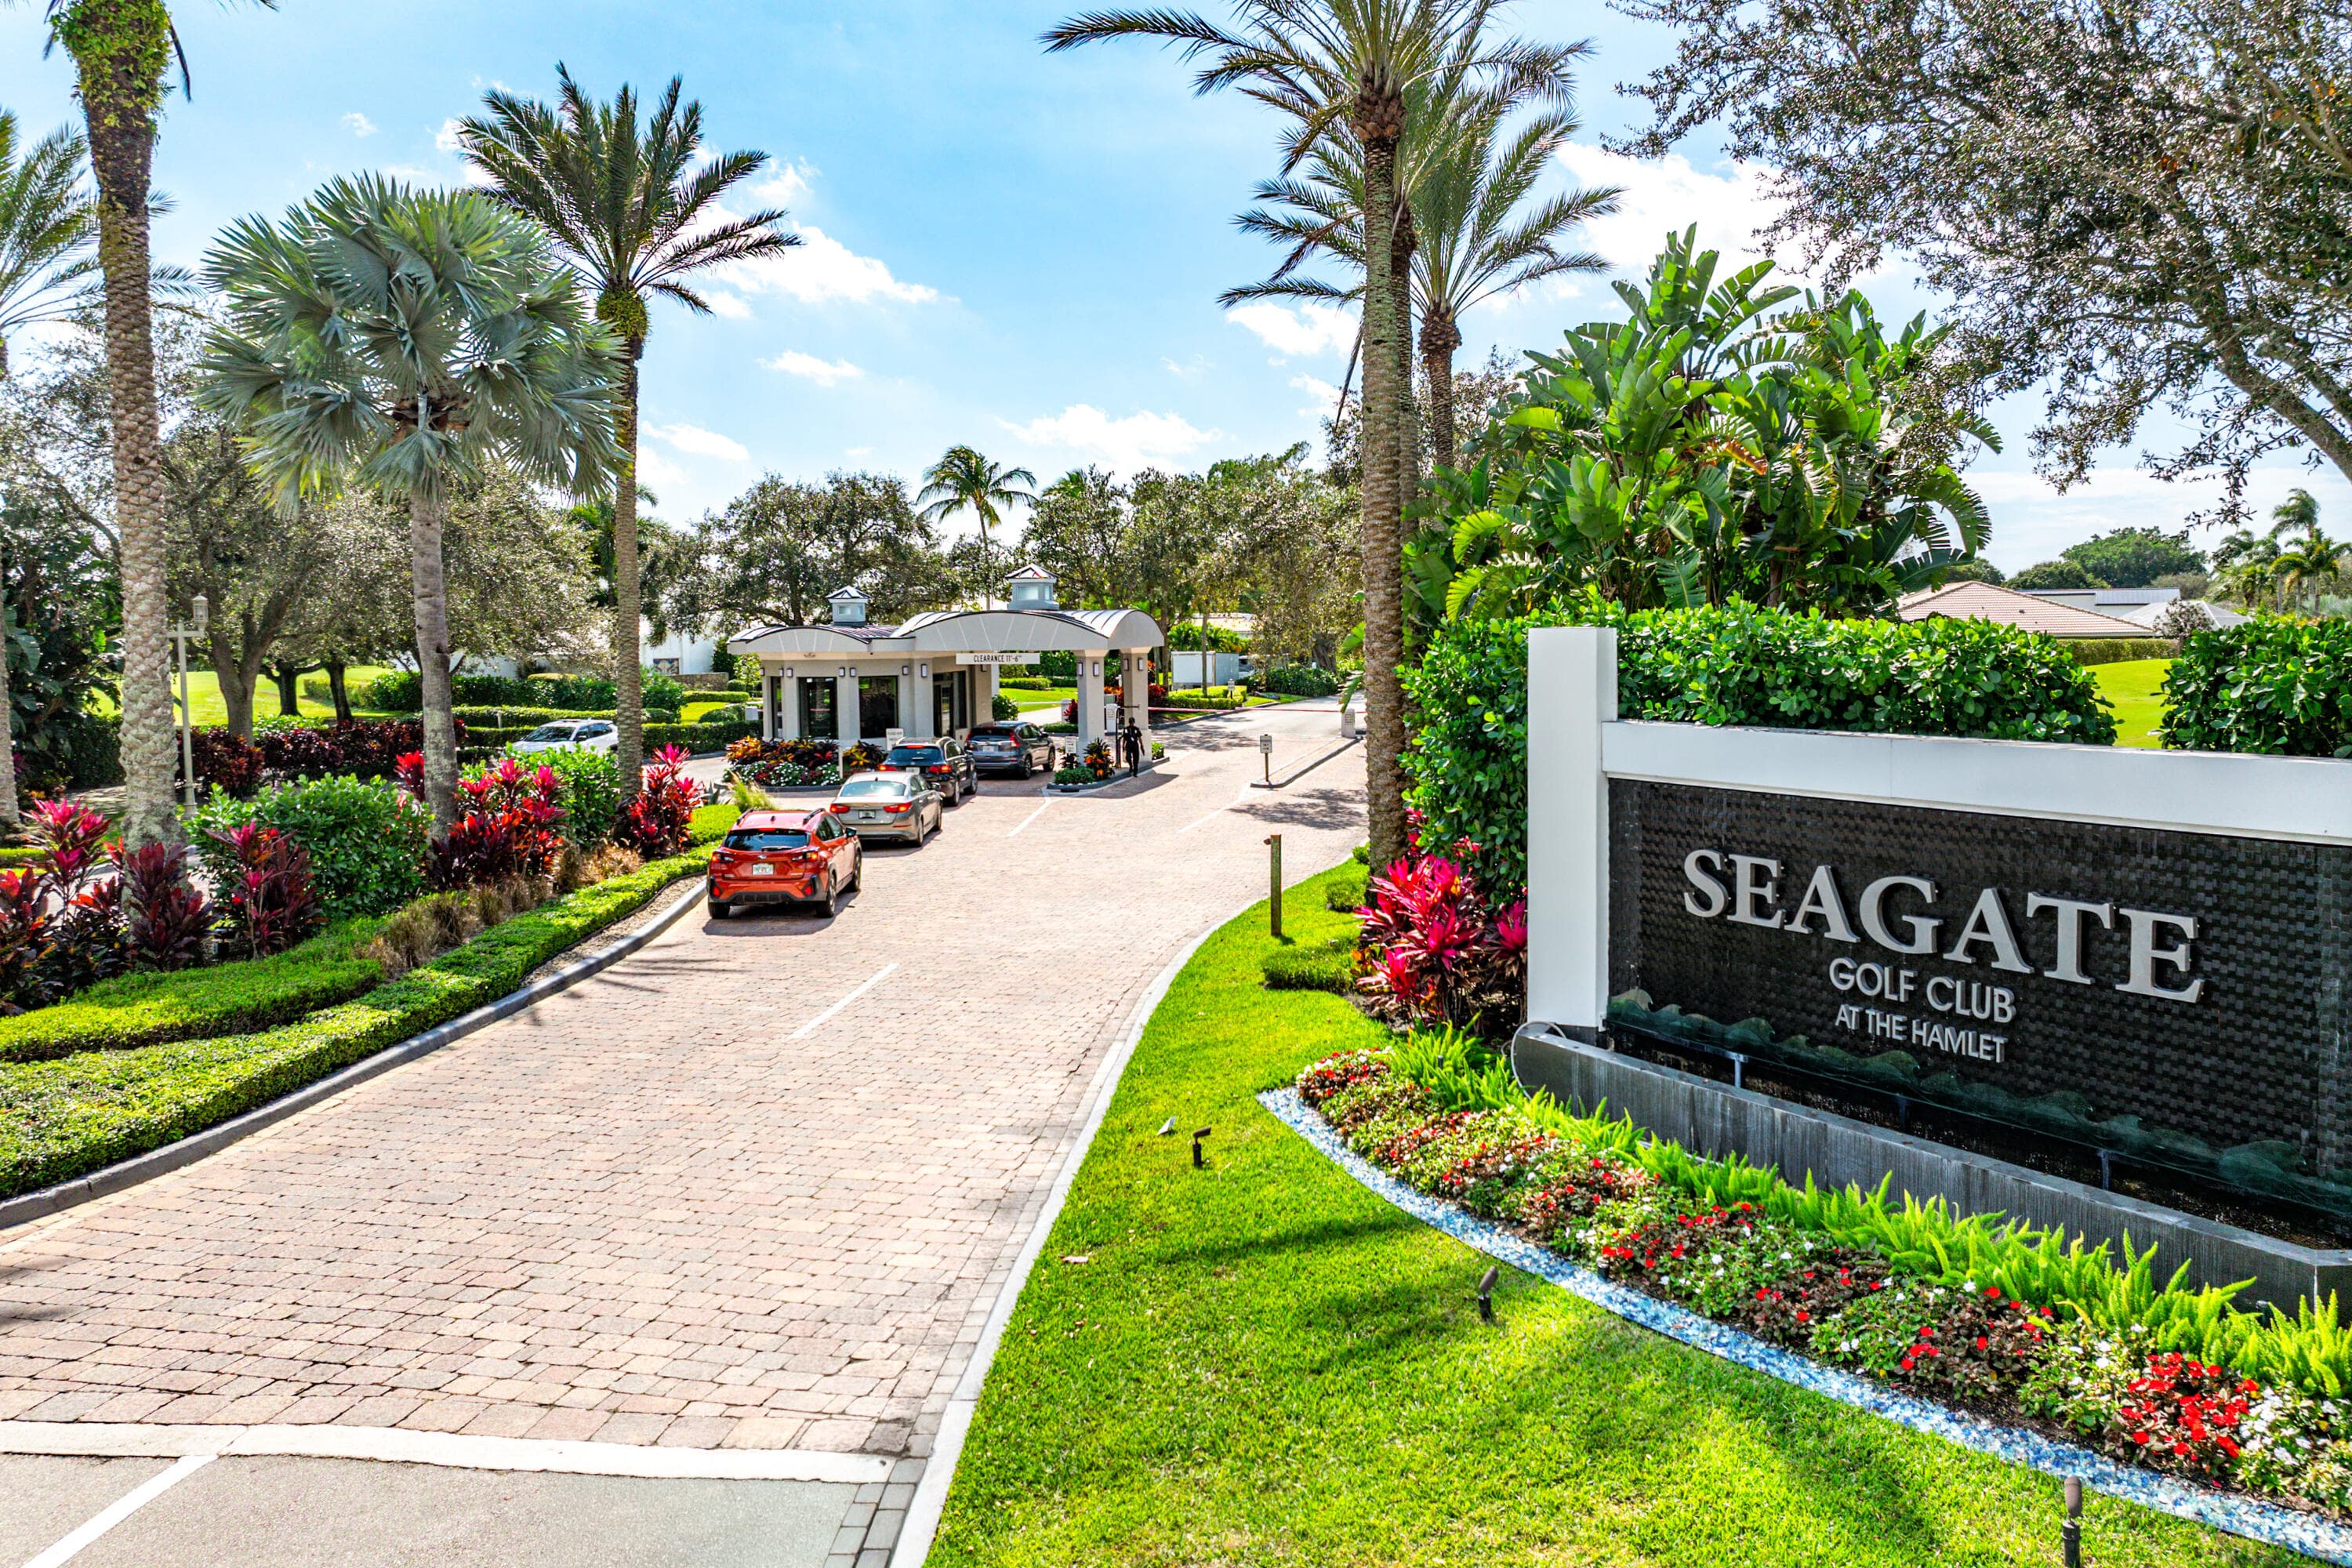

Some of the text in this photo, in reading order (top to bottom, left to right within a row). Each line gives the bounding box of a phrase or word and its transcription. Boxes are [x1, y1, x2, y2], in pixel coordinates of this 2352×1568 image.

[1683, 848, 2205, 1004] SEAGATE
[1829, 956, 2016, 1024] GOLF CLUB
[1835, 1004, 2009, 1063] AT THE HAMLET
